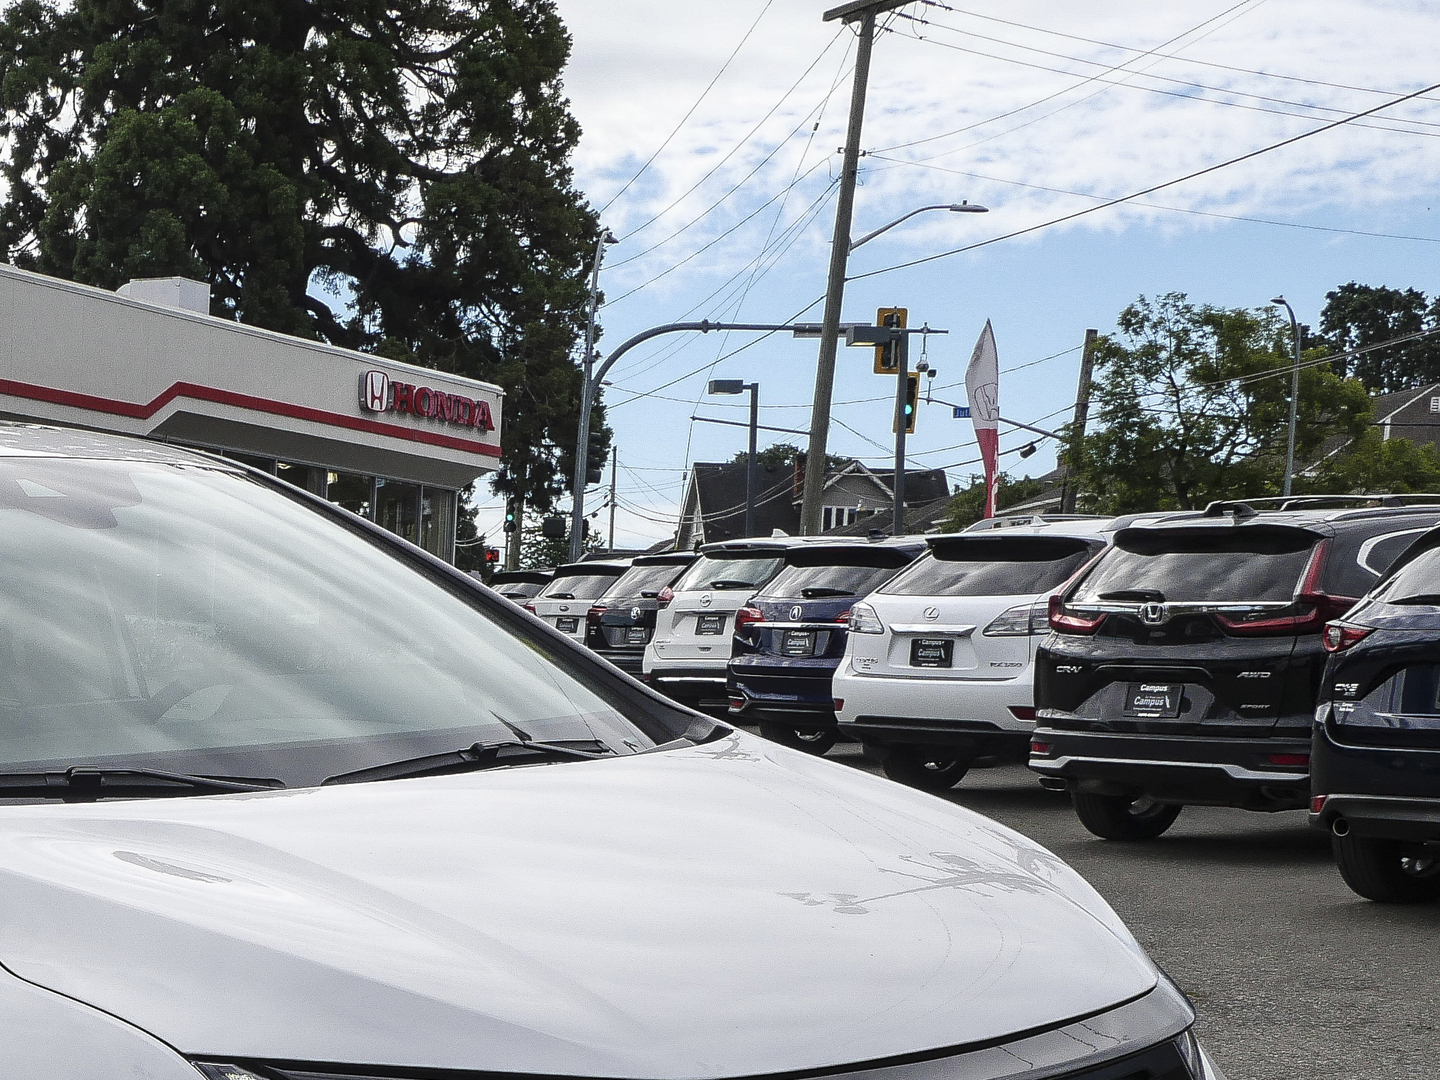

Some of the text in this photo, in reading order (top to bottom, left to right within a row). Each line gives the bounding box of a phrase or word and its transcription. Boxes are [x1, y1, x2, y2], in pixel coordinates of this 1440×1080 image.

[391, 381, 495, 431] HONDA
[1140, 684, 1168, 693] Campus
[1133, 695, 1165, 708] Campus
